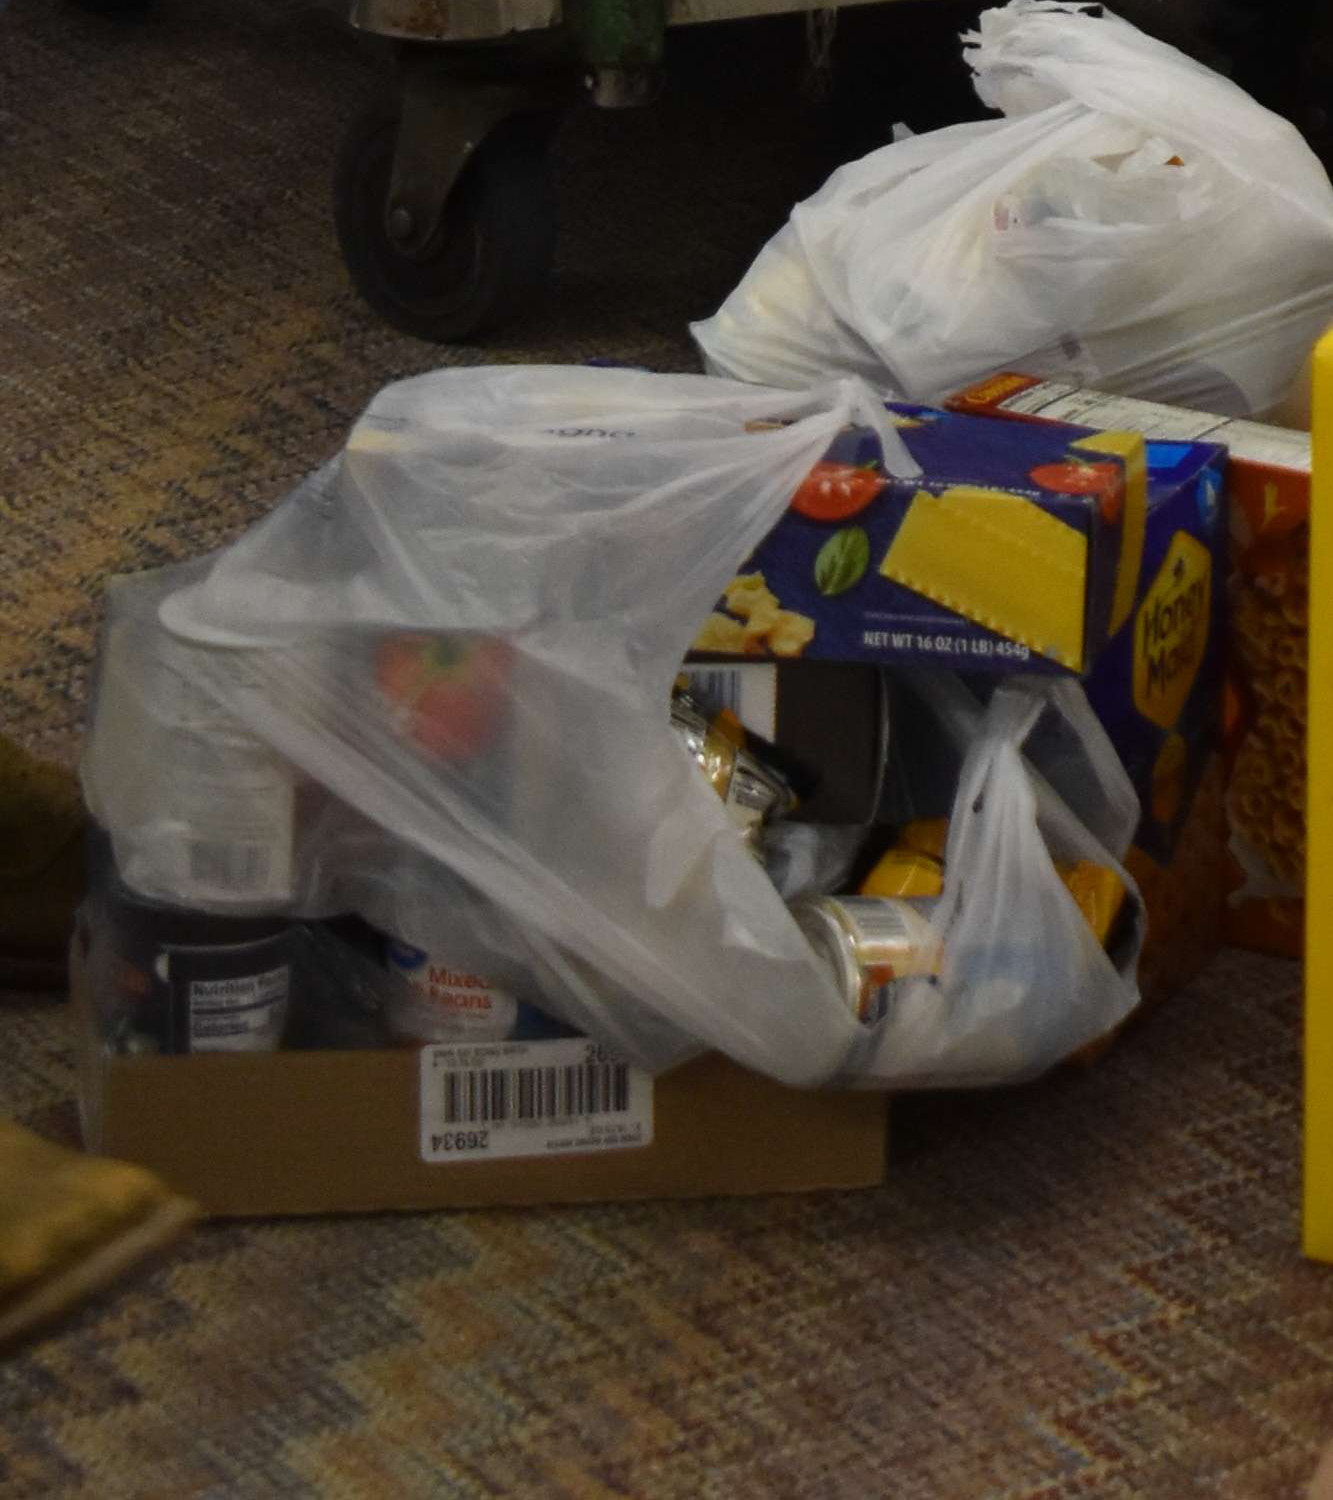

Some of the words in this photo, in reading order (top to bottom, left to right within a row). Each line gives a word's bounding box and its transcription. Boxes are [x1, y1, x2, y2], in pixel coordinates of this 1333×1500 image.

[1143, 579, 1204, 651] Honey
[863, 630, 888, 649] NET
[889, 631, 913, 650] WT
[915, 633, 932, 651] 16
[933, 634, 952, 653] OZ
[954, 635, 967, 657] (1
[969, 636, 996, 659] LB)
[995, 640, 1030, 661] 454g
[431, 1130, 490, 1153] 26934
